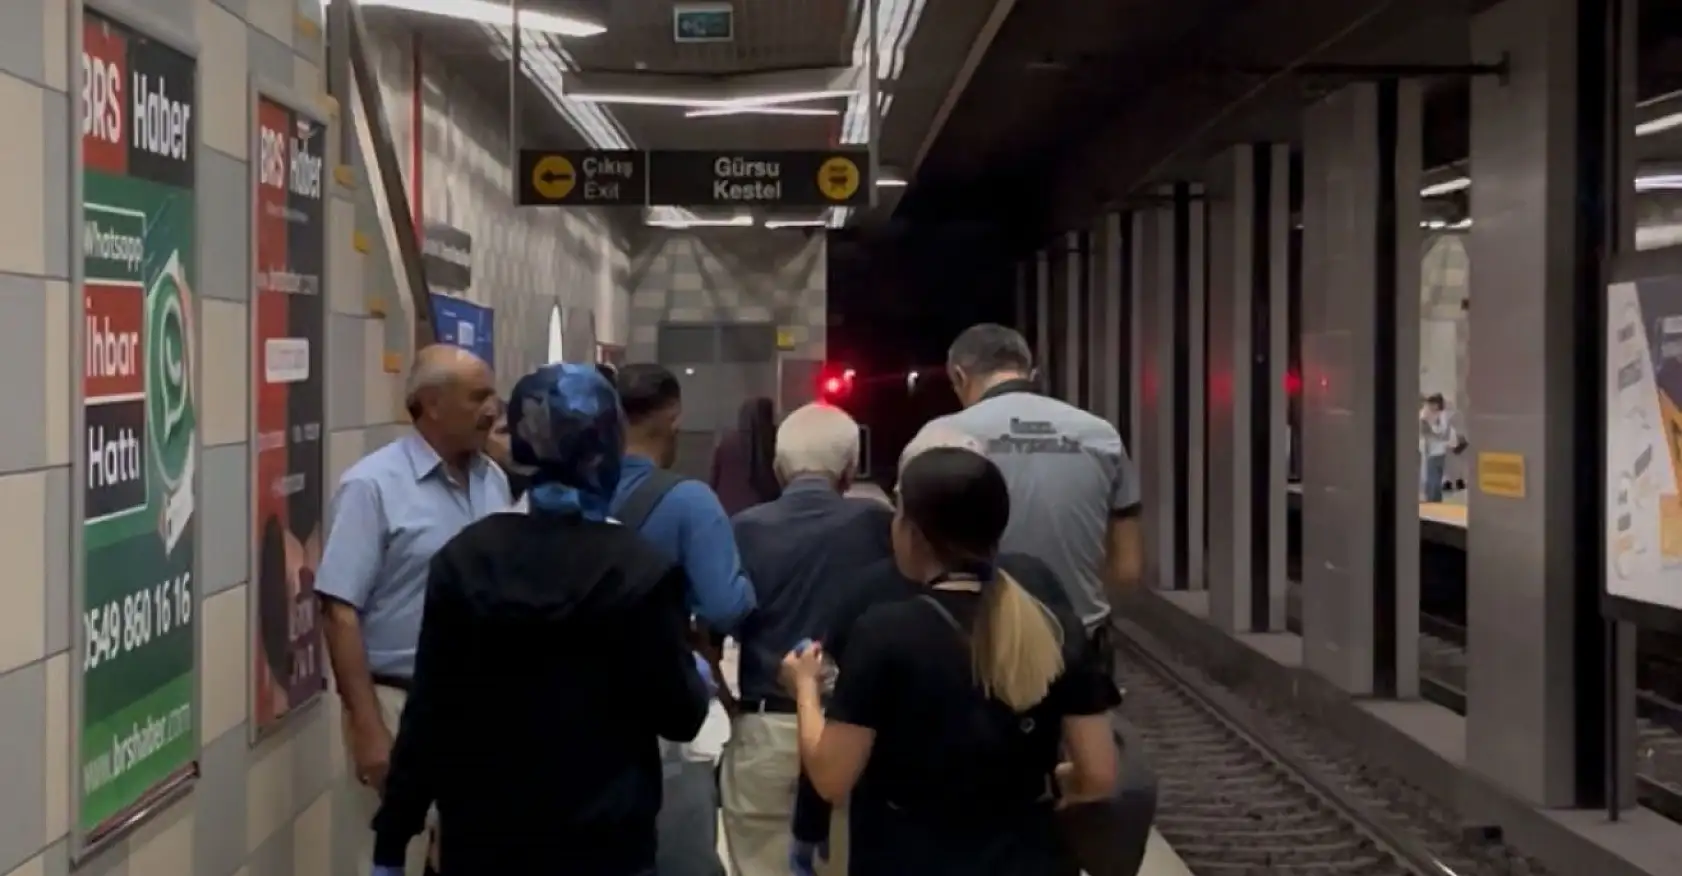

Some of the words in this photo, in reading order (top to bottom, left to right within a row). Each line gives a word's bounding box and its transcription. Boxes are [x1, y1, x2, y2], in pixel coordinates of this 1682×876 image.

[82, 51, 121, 144] BRS
[132, 71, 190, 162] Haber
[261, 124, 285, 189] BRS
[289, 136, 322, 200] Haber
[583, 180, 621, 200] Exit
[713, 179, 782, 200] Kestel
[714, 156, 780, 178] Gürsu
[83, 219, 144, 274] Whatsapp
[88, 425, 140, 489] Hattı
[123, 587, 151, 653] 860
[154, 578, 171, 637] 16
[174, 571, 191, 626] 16
